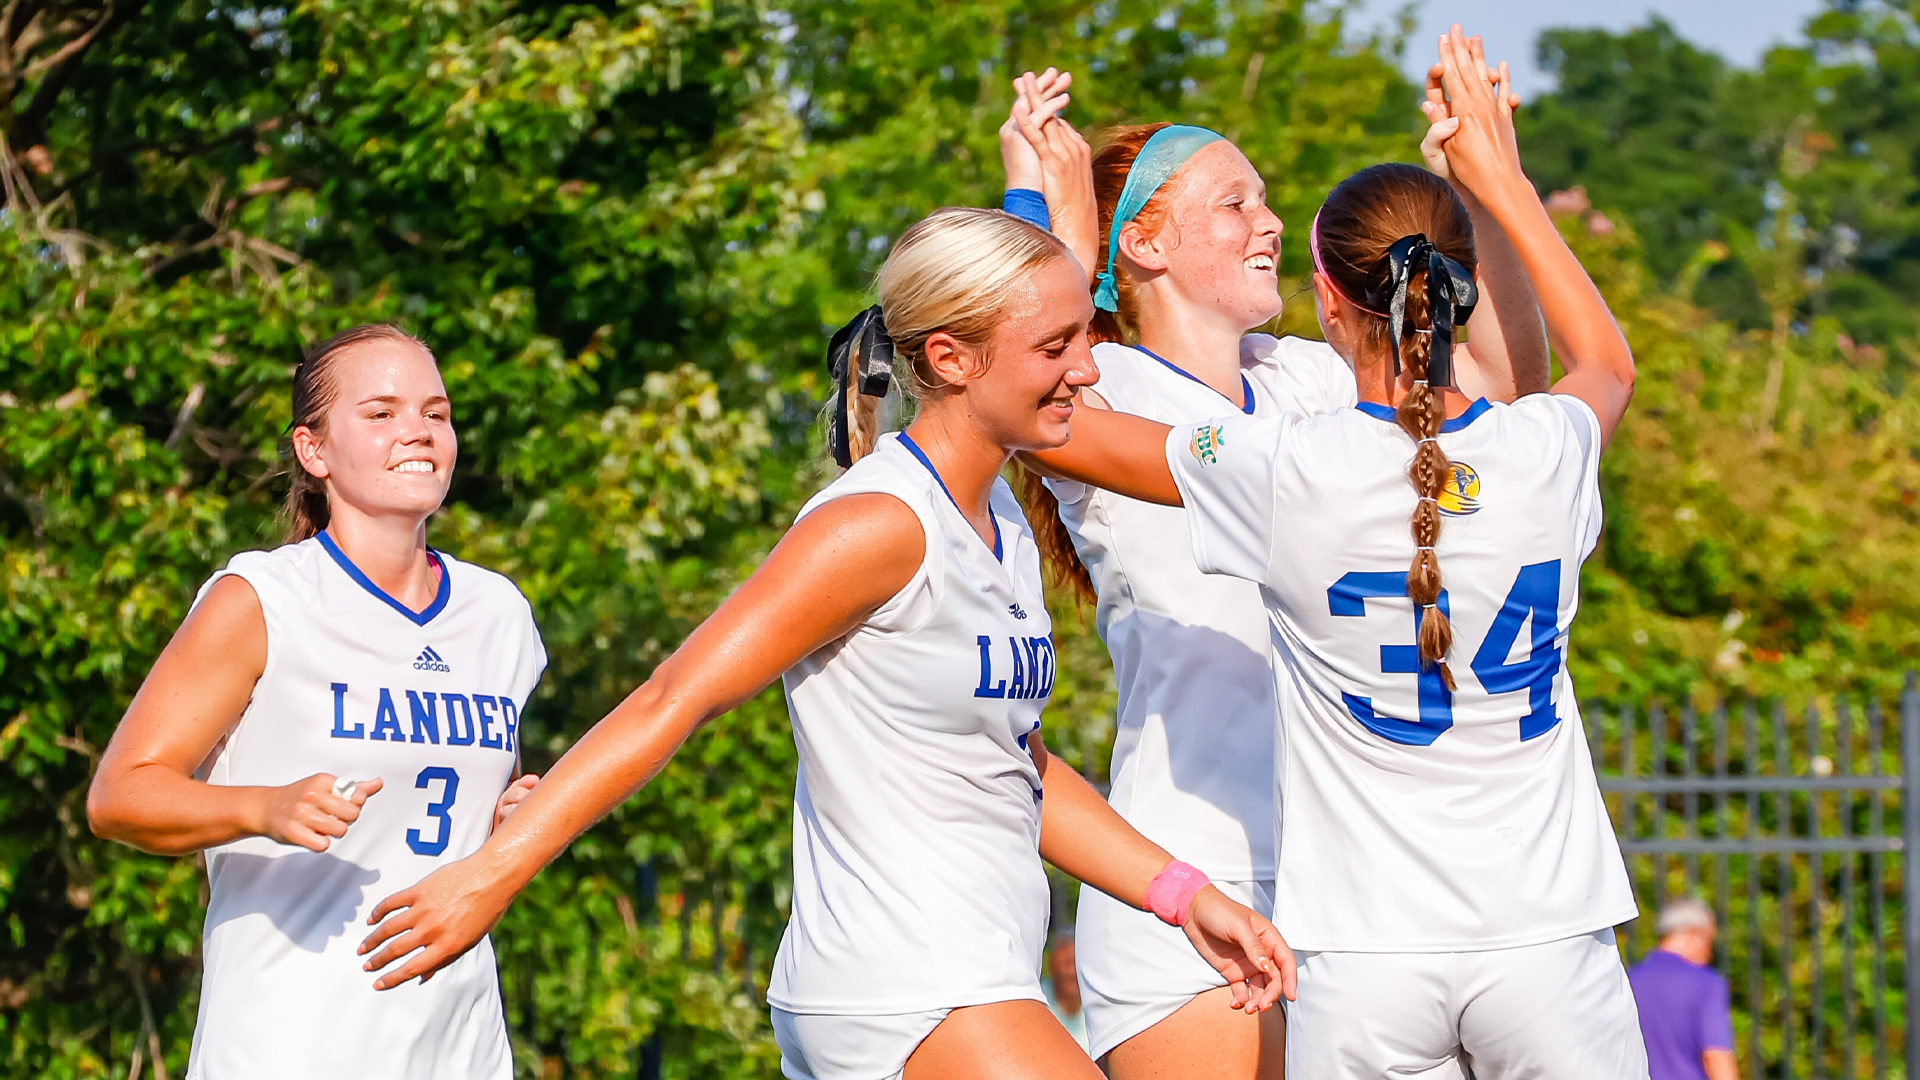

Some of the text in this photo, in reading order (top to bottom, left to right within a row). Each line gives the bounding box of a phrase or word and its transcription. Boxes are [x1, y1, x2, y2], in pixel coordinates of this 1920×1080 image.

[1197, 425, 1217, 466] PBC
[412, 660, 451, 673] adidas
[973, 633, 1053, 699] LAND
[1326, 558, 1562, 746] 34
[330, 682, 518, 752] LANDER
[405, 766, 460, 857] 3
